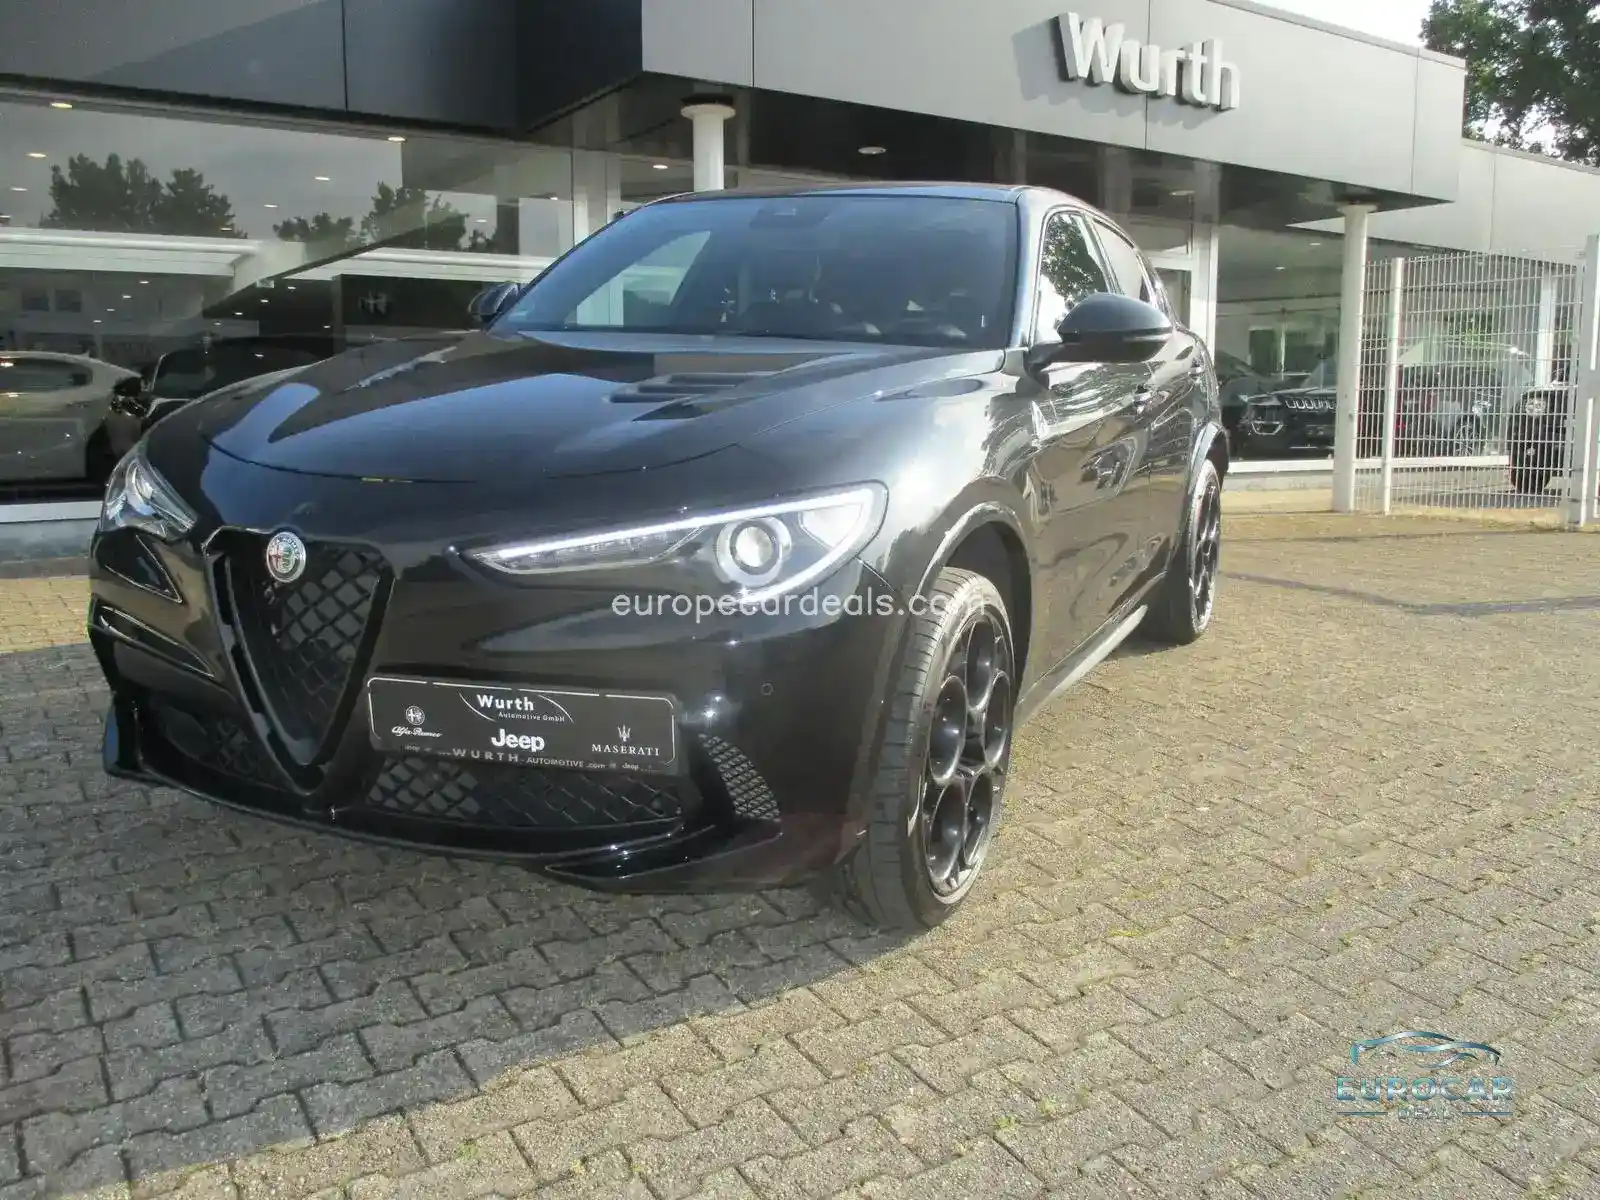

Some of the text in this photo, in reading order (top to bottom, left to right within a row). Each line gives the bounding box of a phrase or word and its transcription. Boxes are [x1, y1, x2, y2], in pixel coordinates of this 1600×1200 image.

[1056, 12, 1240, 110] Wurth
[476, 694, 534, 711] Wurth
[498, 711, 565, 722] Automotive GmbH
[491, 728, 545, 752] Jeep
[591, 743, 660, 756] MASERATI
